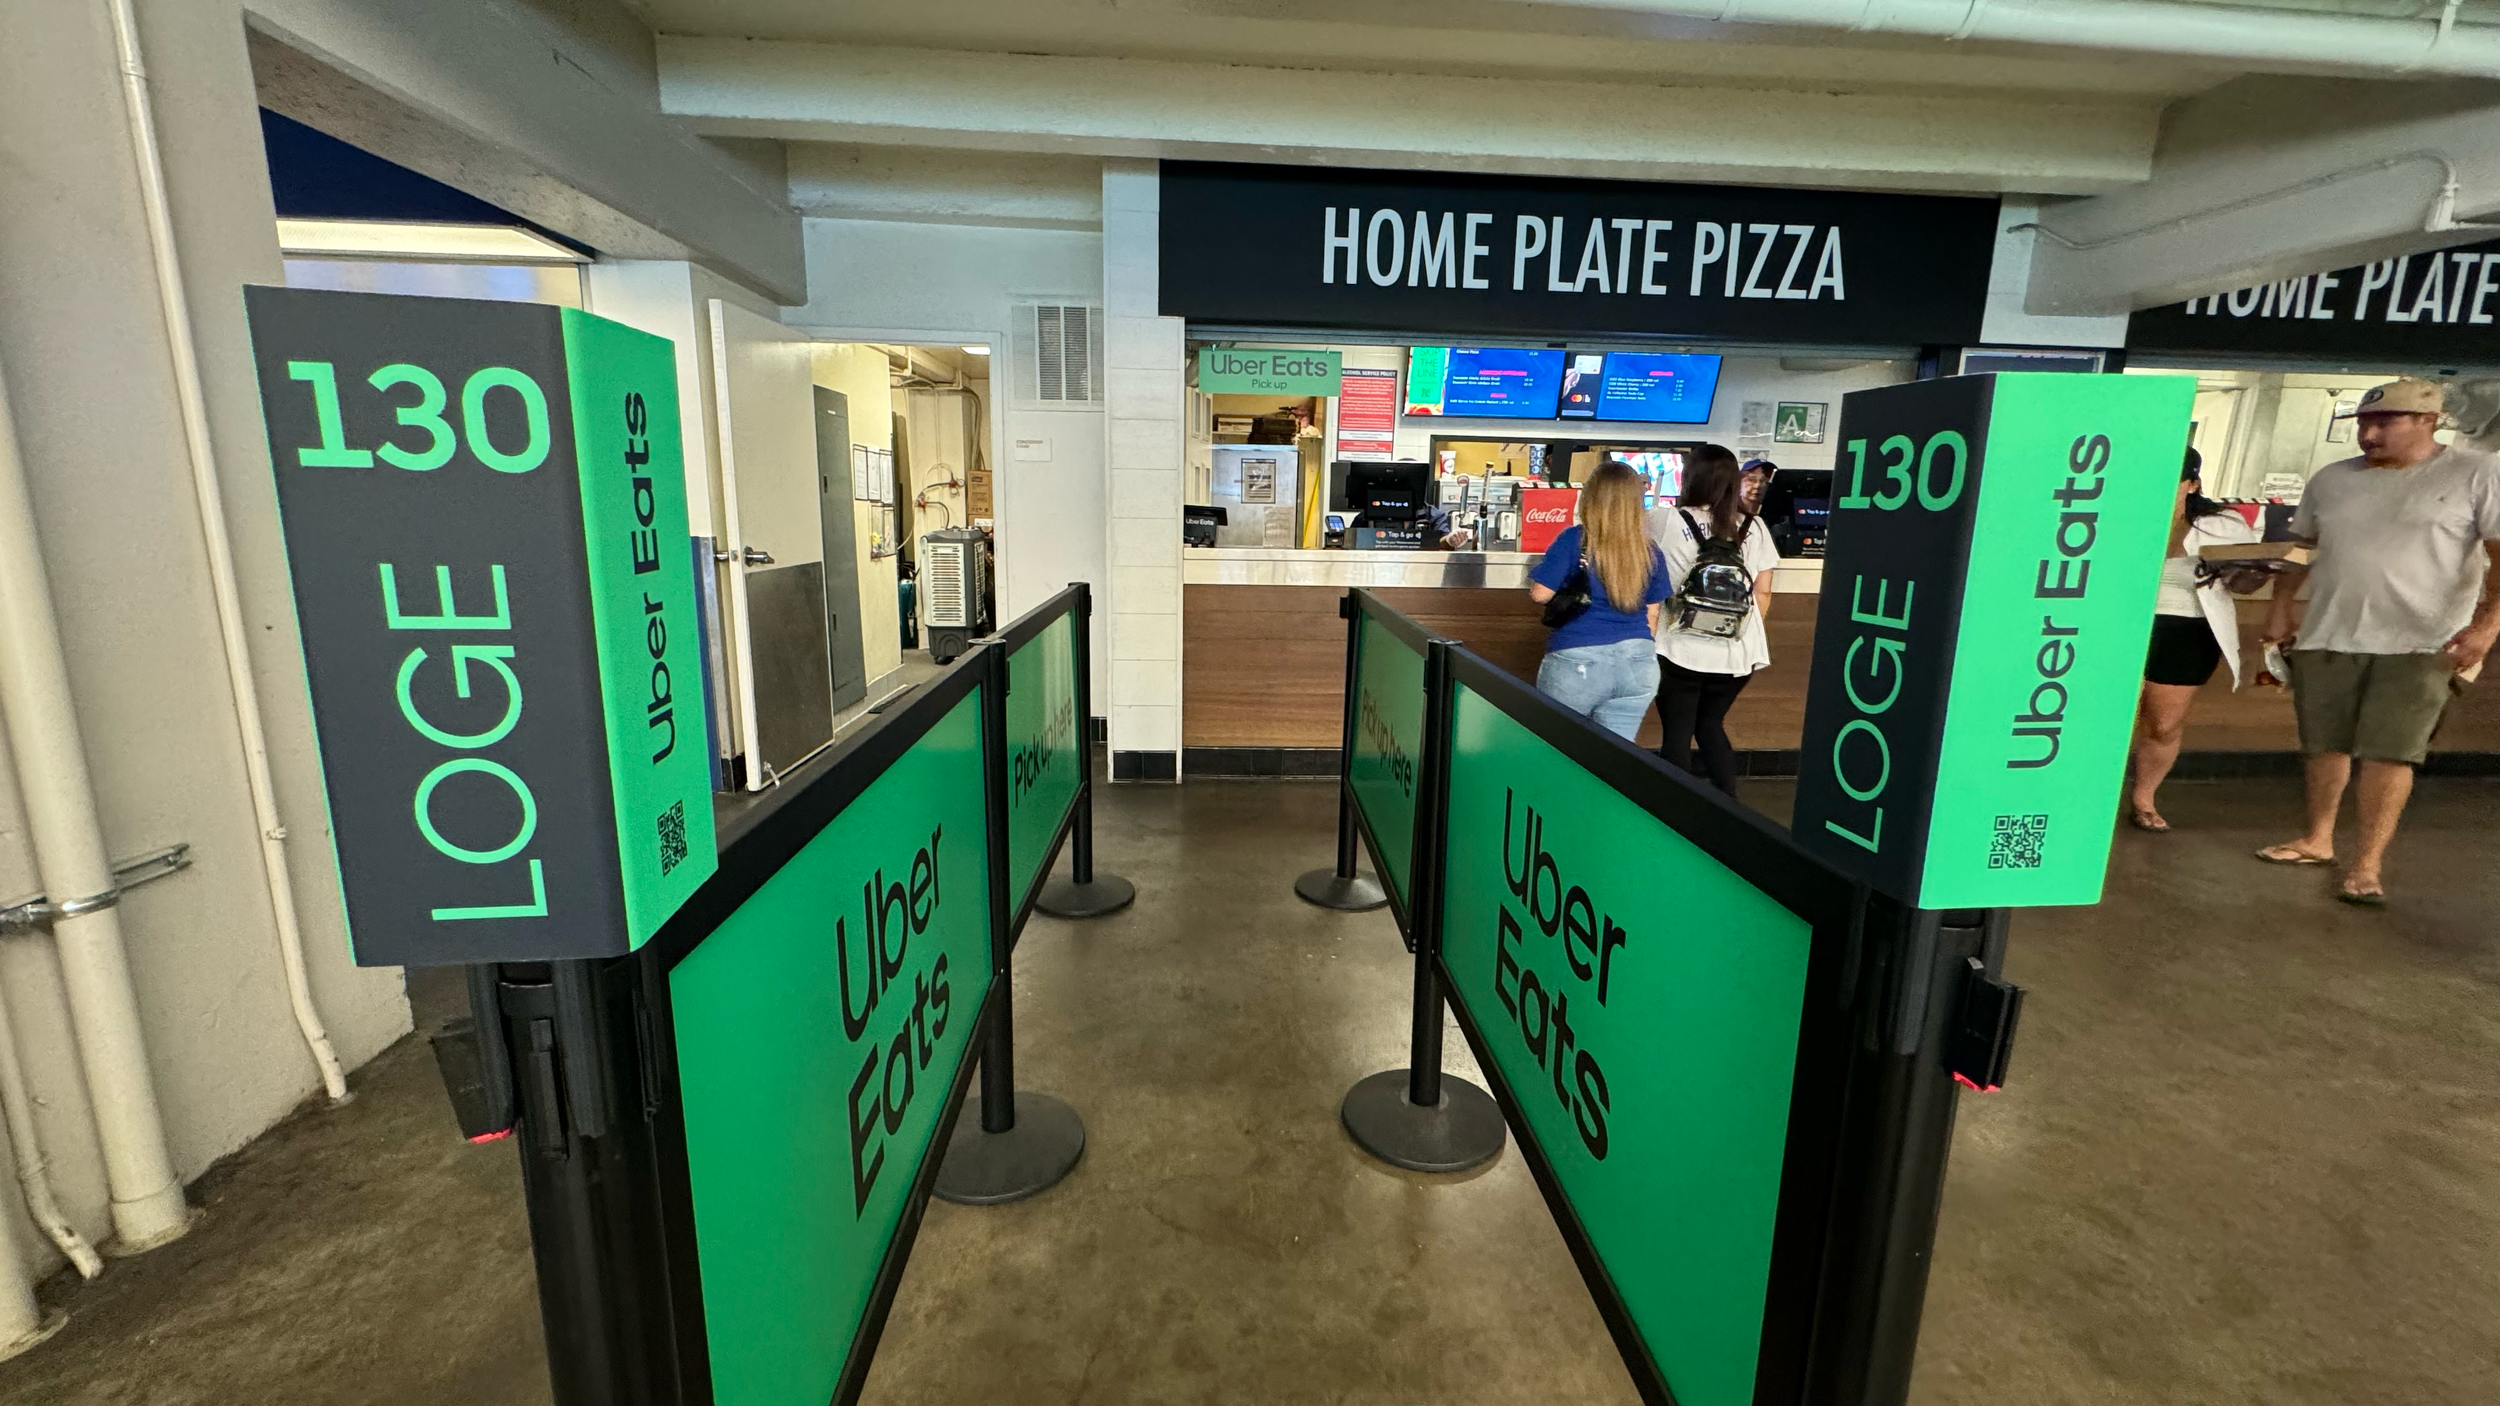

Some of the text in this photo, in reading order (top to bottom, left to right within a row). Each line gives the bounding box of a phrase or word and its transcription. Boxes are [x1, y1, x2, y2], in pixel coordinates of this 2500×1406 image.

[1323, 207, 1845, 300] HOME PLATE PIZZA
[2186, 252, 2500, 324] ME PLATE
[1210, 353, 1328, 377] Uber Eats
[1251, 379, 1288, 391] Pick up
[1417, 369, 1438, 378] LINE
[1420, 358, 1438, 367] THE
[286, 360, 551, 474] 130
[1781, 413, 1800, 434] A
[1526, 508, 1568, 523] Coca-Cola
[1838, 430, 1968, 512] 130
[624, 391, 676, 766] Uber Eats
[1388, 531, 1400, 539] Tap
[2006, 434, 2111, 770] Uber Eats
[378, 562, 549, 921] LOGE
[1014, 696, 1072, 808] Pick up here
[1377, 718, 1388, 770] up
[1389, 722, 1411, 798] here
[1825, 574, 1915, 855] LOGE
[835, 822, 942, 1042] Uber
[1503, 786, 1627, 1008] Uber
[1495, 902, 1611, 1161] Eats
[848, 951, 950, 1223] Eats
